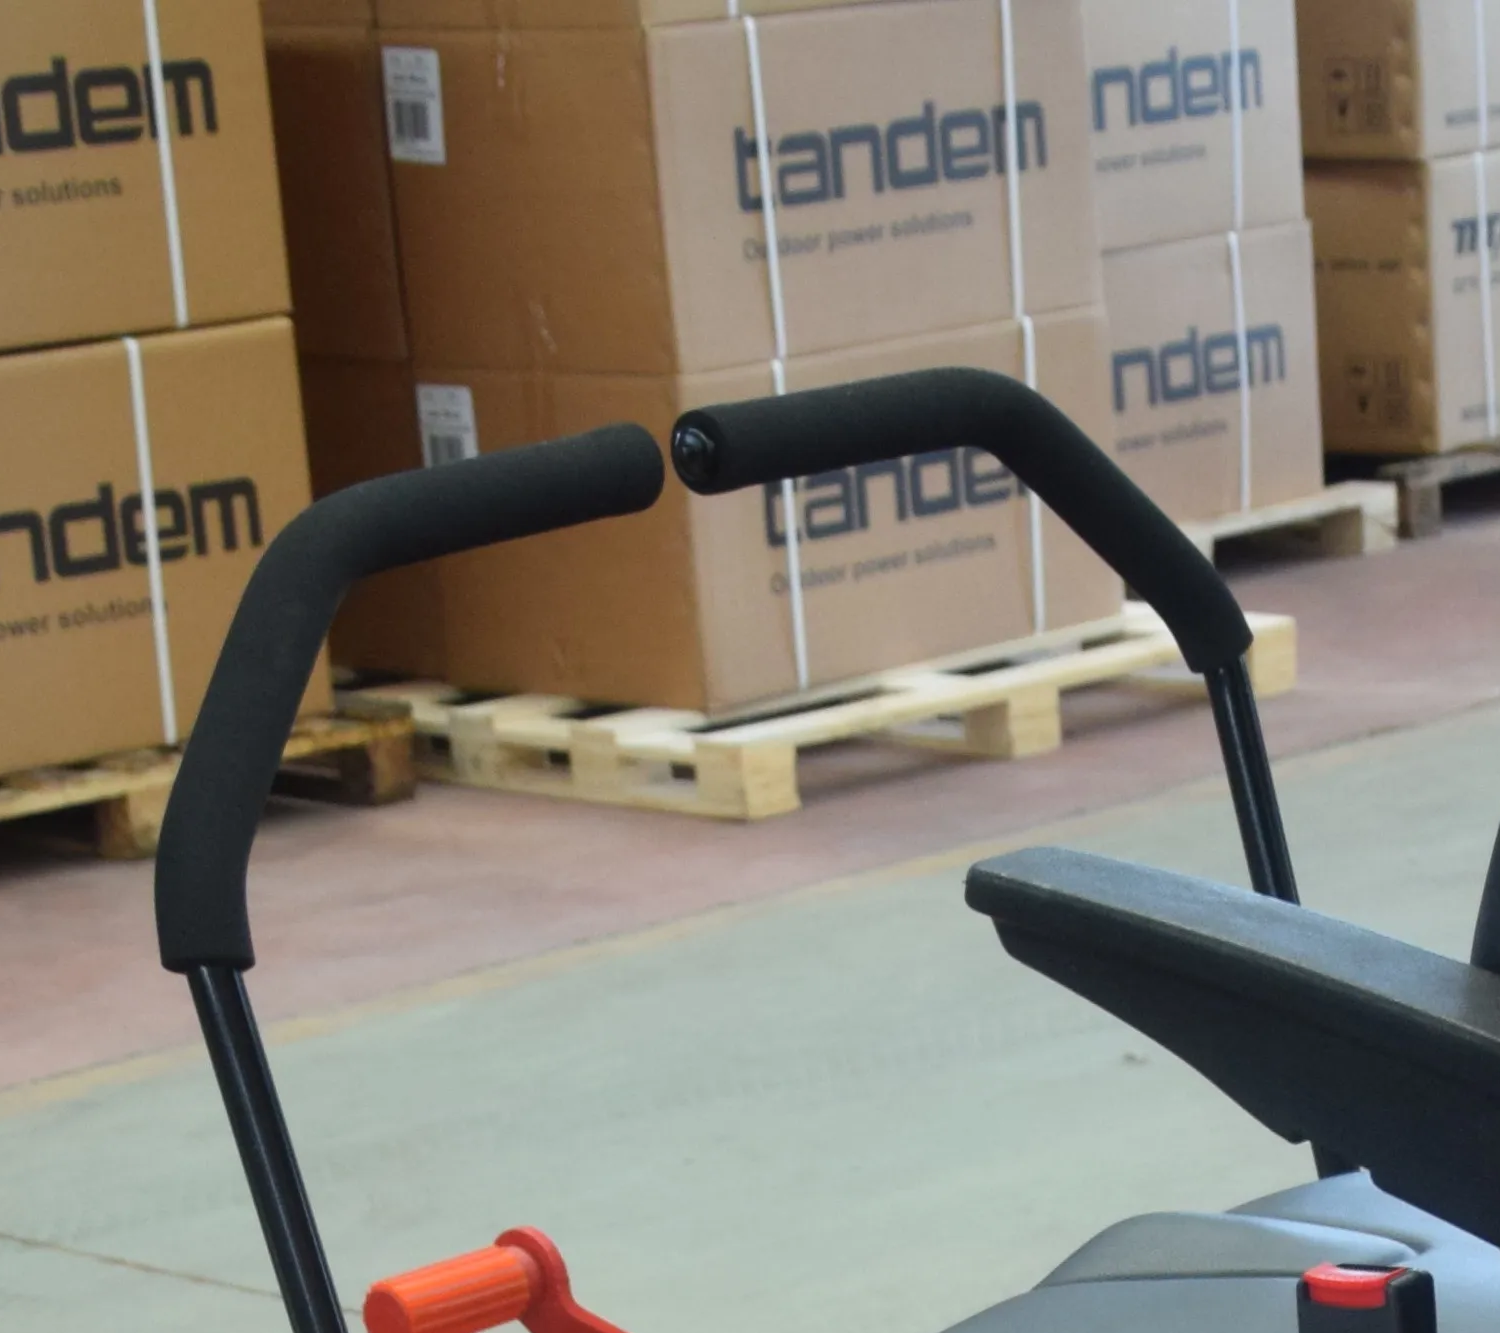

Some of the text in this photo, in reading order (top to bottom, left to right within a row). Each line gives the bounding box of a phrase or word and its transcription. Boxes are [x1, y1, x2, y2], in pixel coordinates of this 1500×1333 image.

[1092, 45, 1263, 132] ndem
[11, 174, 124, 206] solutions
[733, 99, 1048, 214] tandem
[1112, 321, 1286, 415] ndem
[763, 448, 1028, 547] tande
[58, 596, 168, 630] solution
